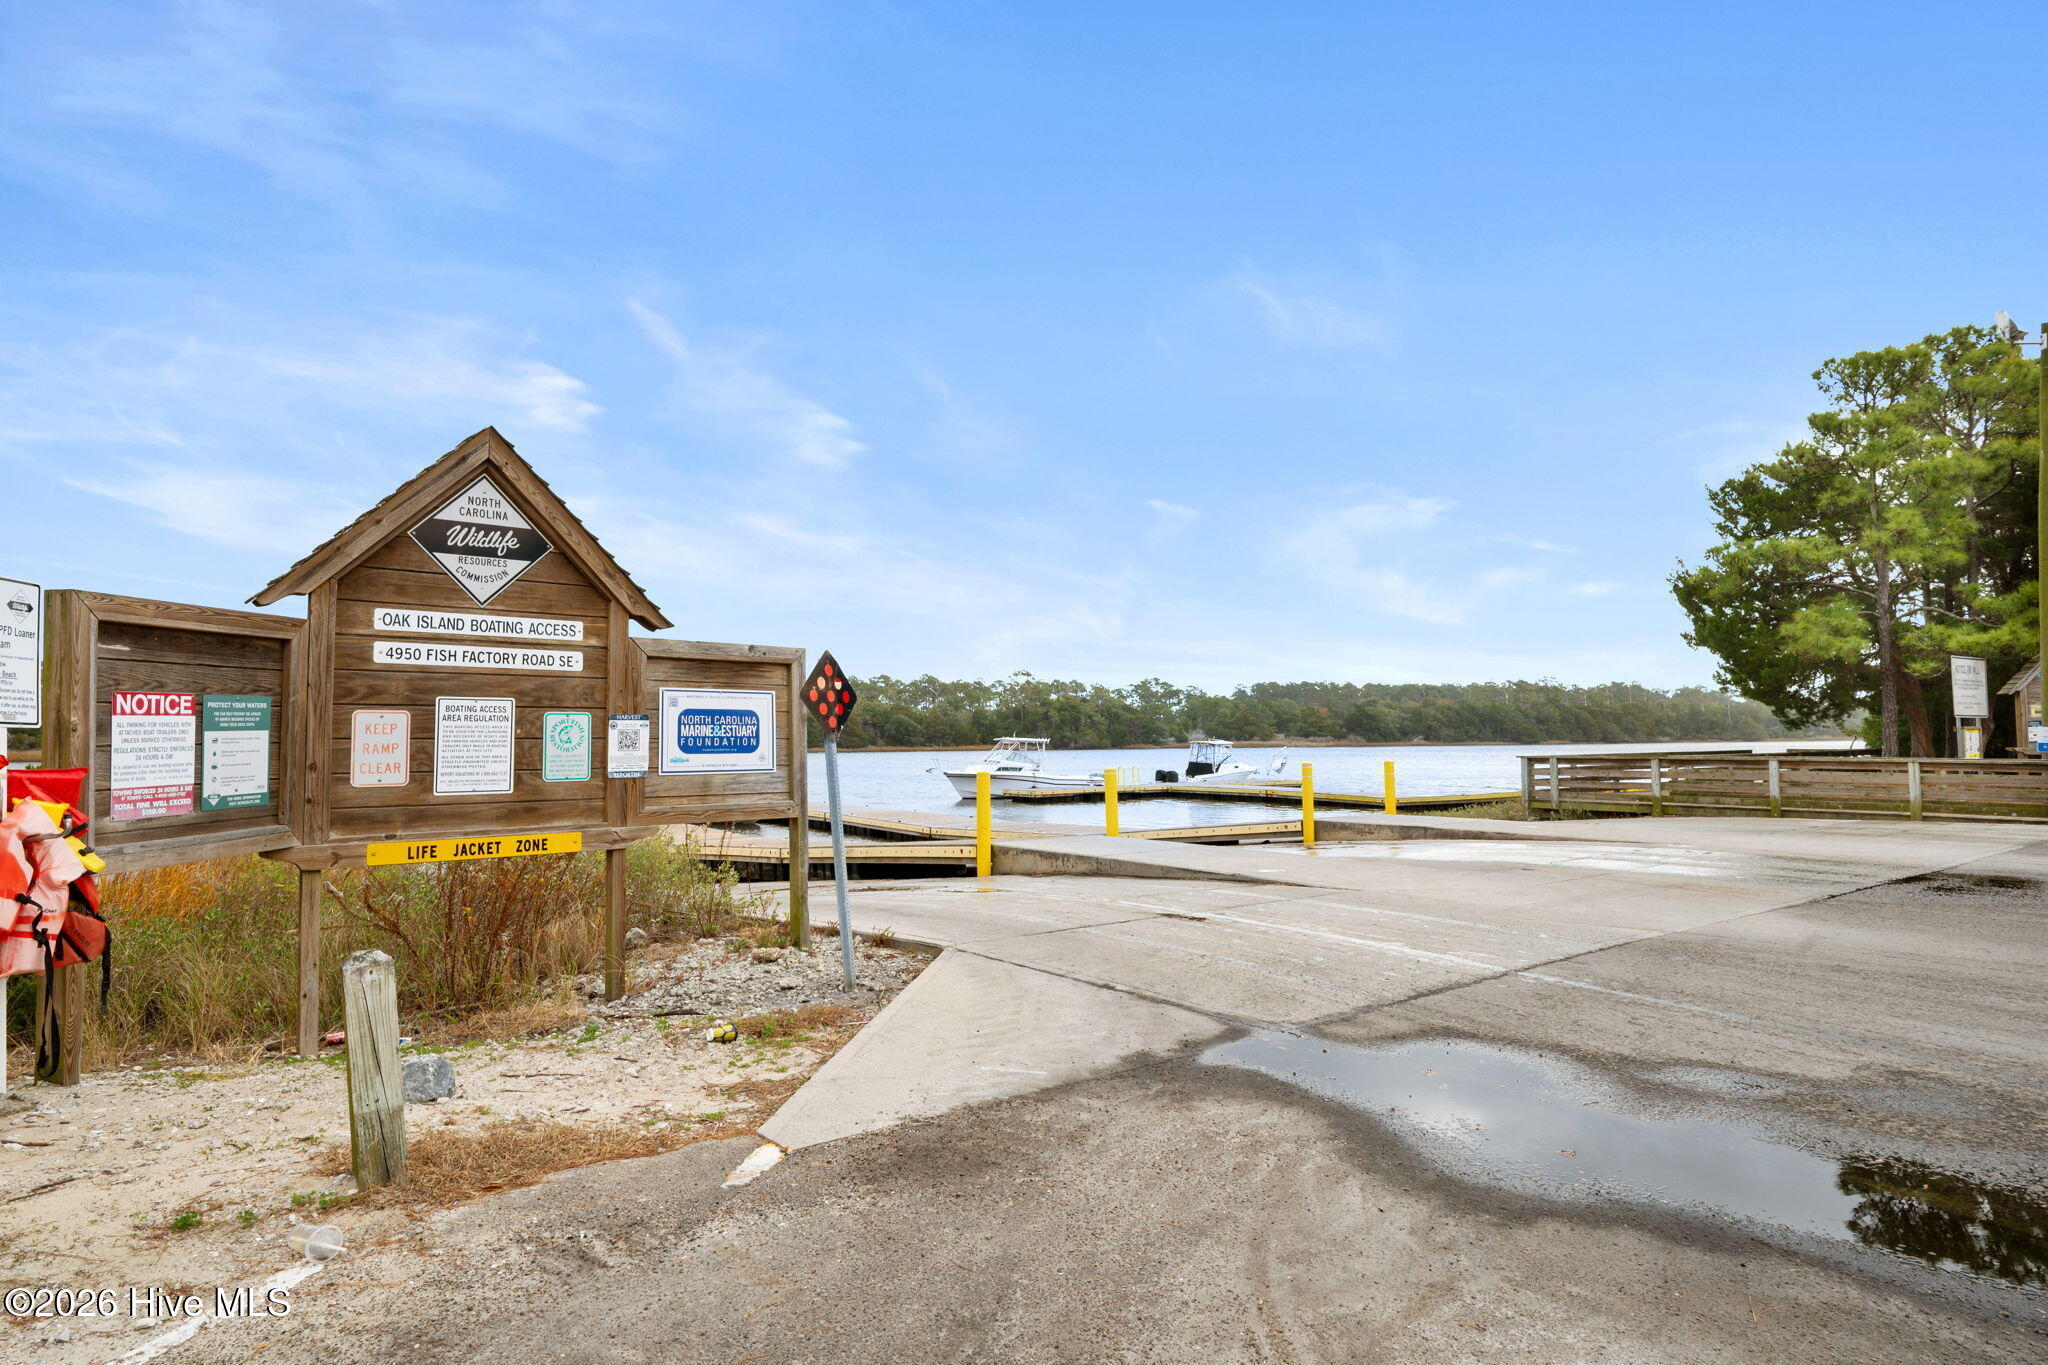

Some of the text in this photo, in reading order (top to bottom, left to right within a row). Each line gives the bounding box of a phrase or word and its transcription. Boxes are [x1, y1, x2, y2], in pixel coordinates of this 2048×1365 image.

[468, 496, 500, 508] NORTH
[460, 507, 508, 520] CAROLINA
[447, 525, 520, 556] Wildlife
[459, 556, 508, 567] RESOURCES
[456, 566, 509, 583] COMMISSION
[382, 612, 576, 636] OAK ISLAND BOATING ACCESS
[15, 628, 35, 639] Loaner
[386, 646, 573, 667] 4950 FISH FACTORY ROAD SE
[116, 694, 192, 714] NOTICE
[681, 715, 757, 724] NORTH CAROLINA
[366, 723, 398, 734] KEEP
[680, 738, 756, 746] FOUNDATION
[363, 743, 399, 754] RAMP
[360, 762, 401, 774] CLEAR
[408, 838, 548, 859] LIFE JACKET ZONE
